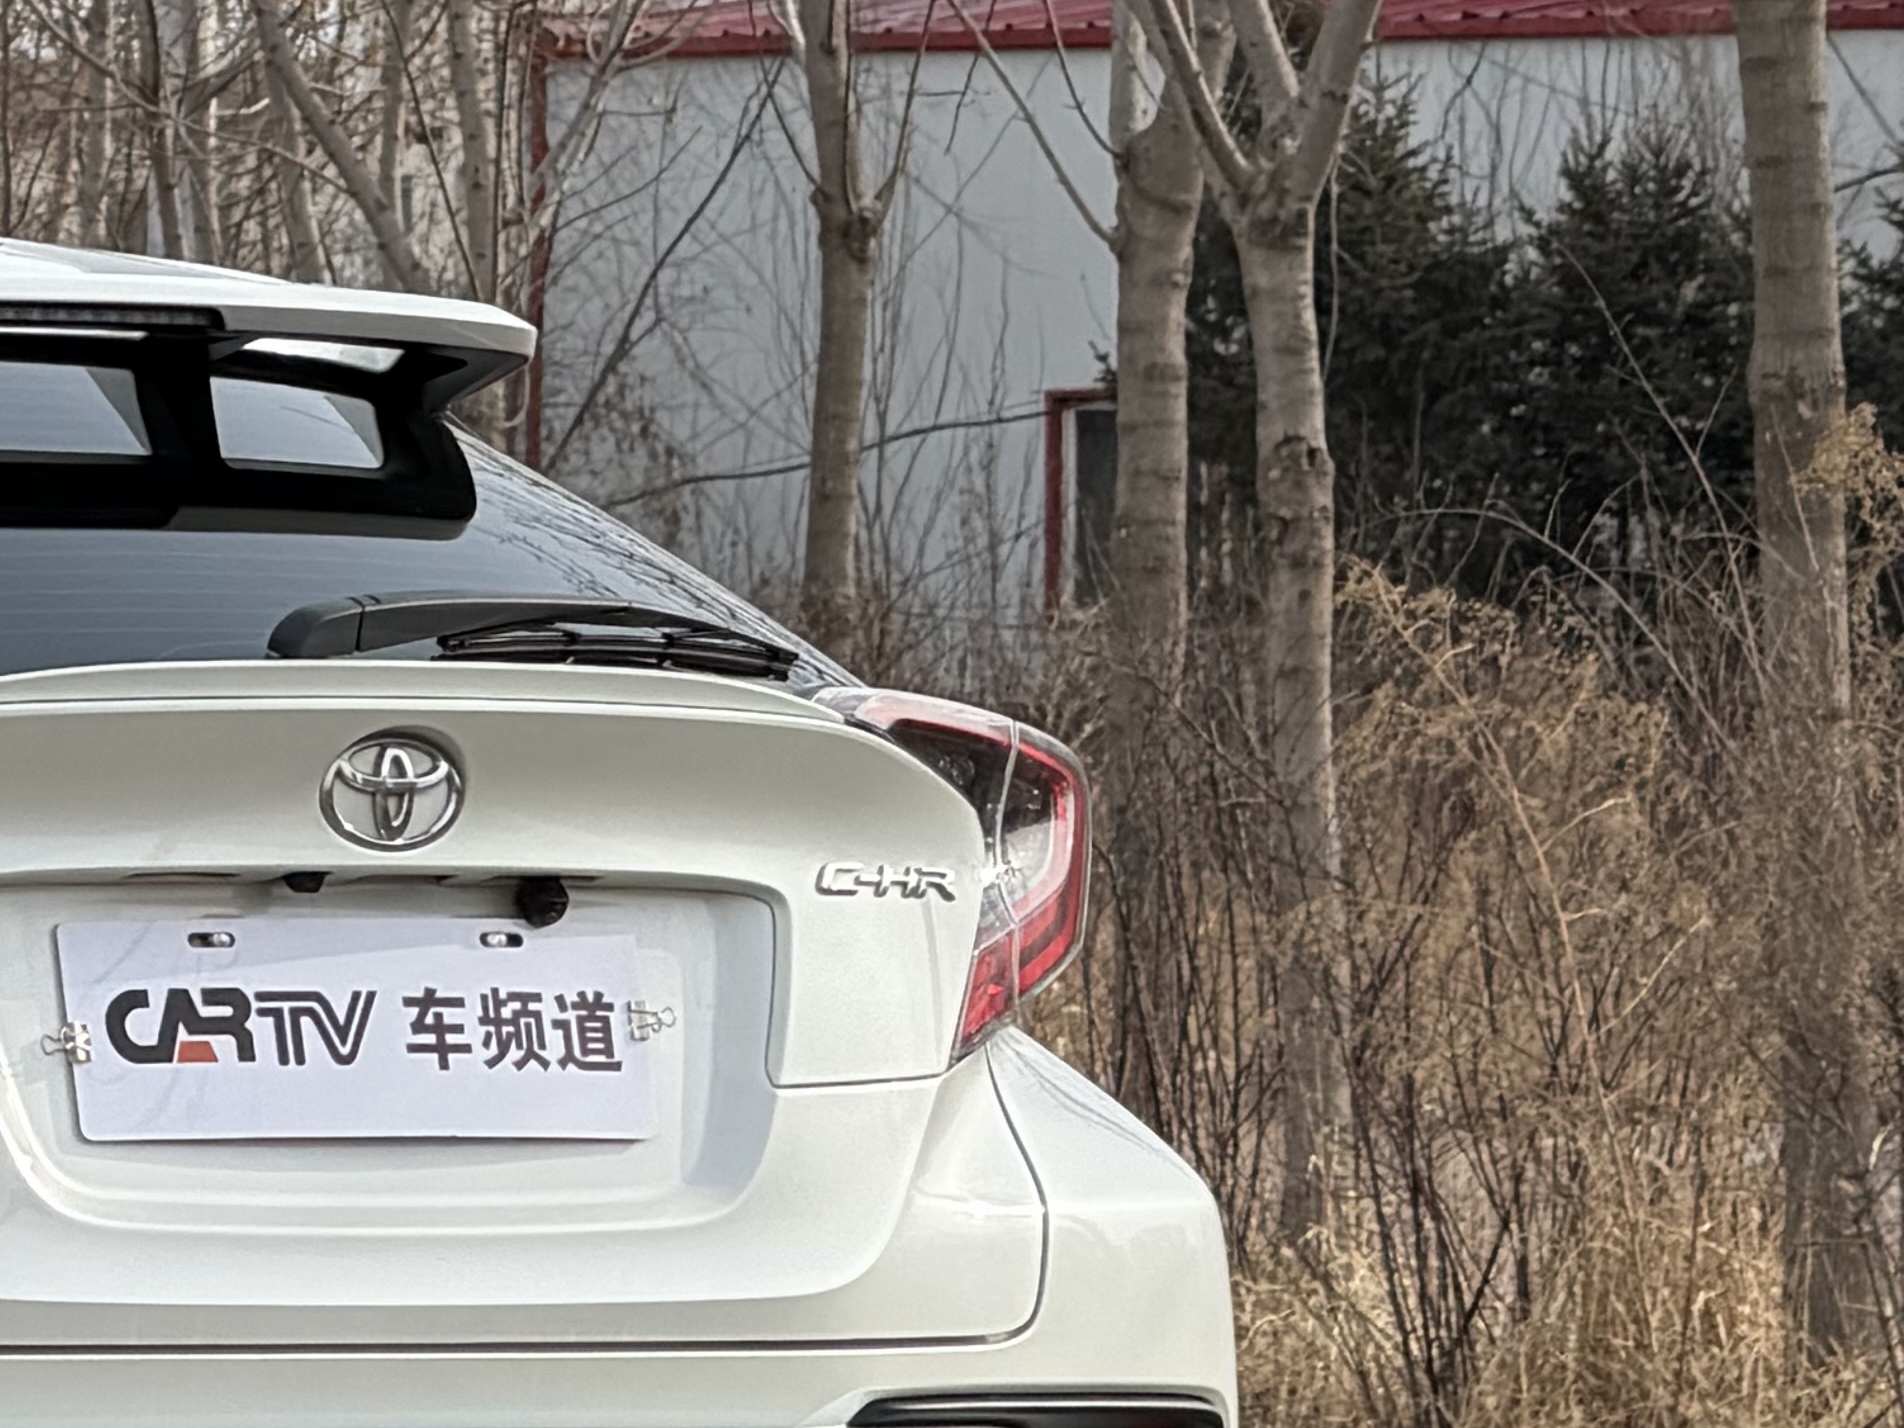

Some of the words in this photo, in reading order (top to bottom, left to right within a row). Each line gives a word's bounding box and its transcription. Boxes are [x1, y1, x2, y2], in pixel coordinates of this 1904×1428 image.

[814, 861, 956, 902] C-HR
[105, 987, 377, 1067] CARTV
[401, 986, 624, 1073] 车频道
